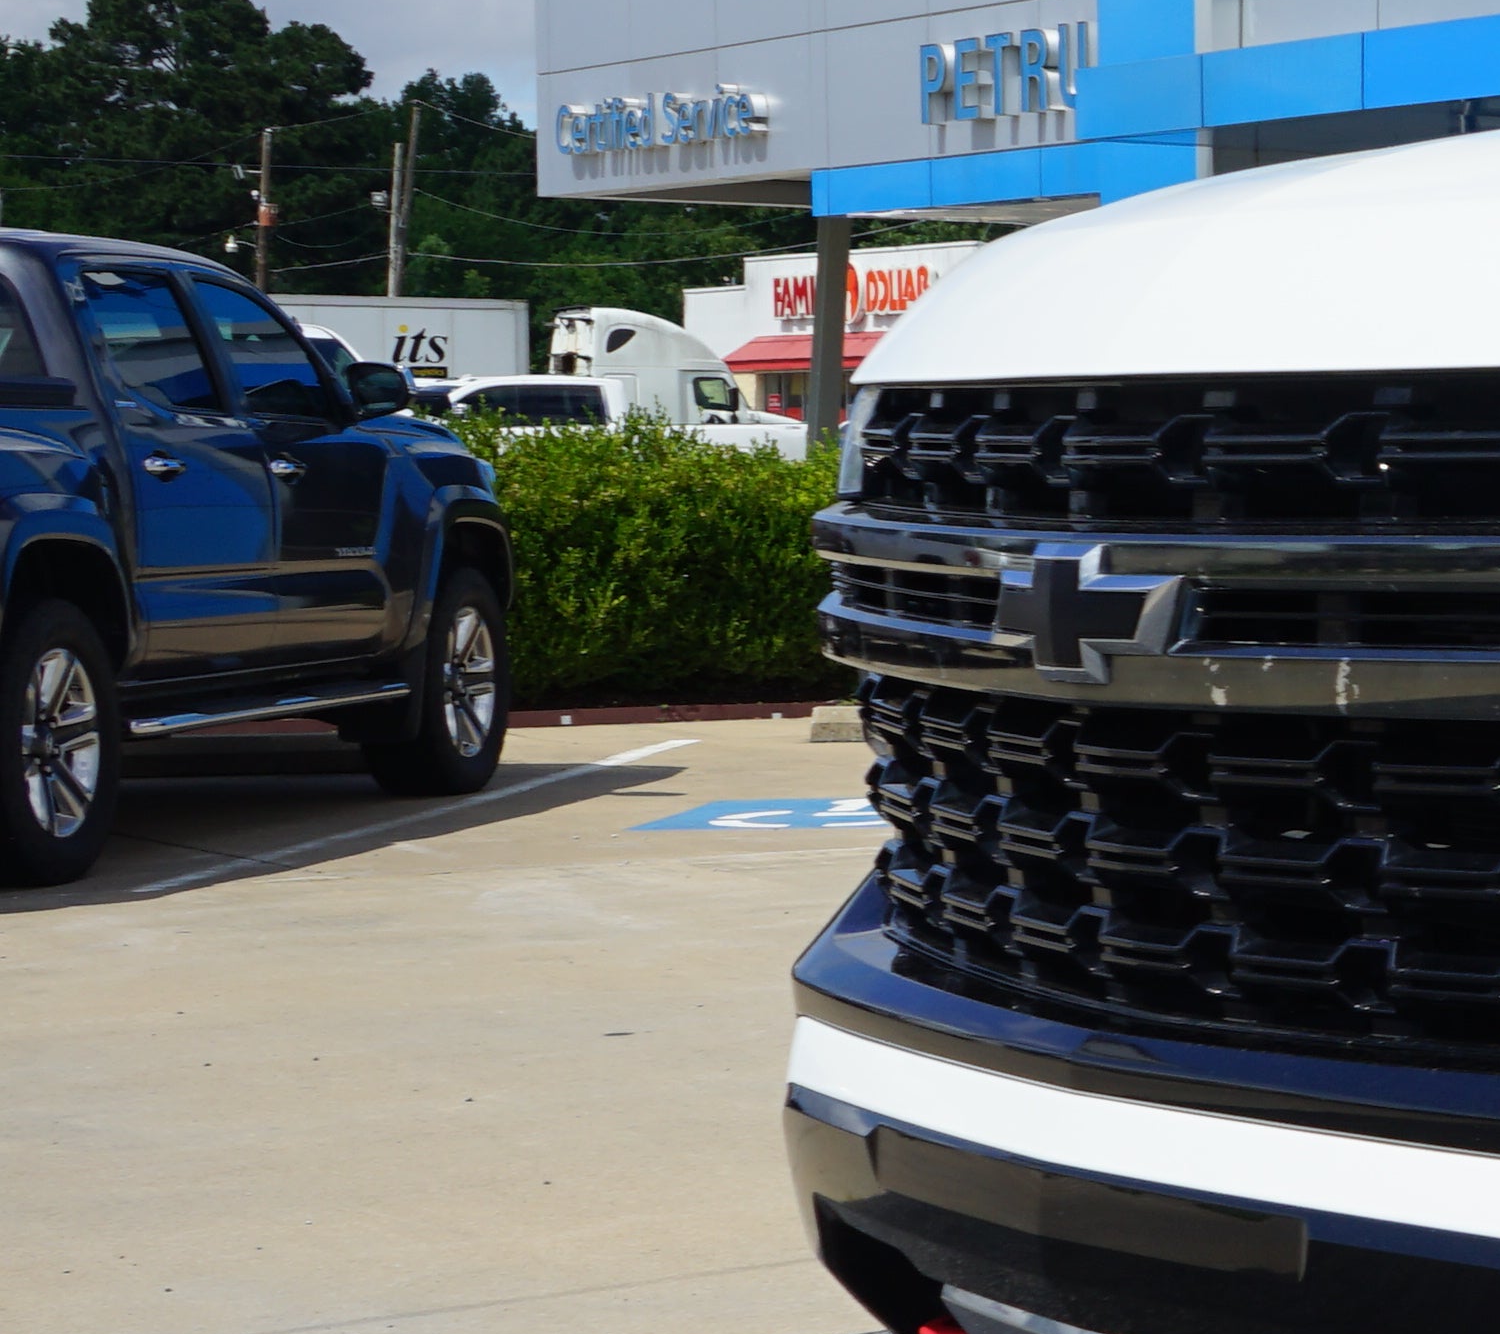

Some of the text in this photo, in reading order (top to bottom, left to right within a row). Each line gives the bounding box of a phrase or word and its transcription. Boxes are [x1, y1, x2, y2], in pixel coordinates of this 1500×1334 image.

[556, 83, 762, 156] Certified Service
[773, 275, 816, 317] FAMI
[392, 324, 448, 364] its
